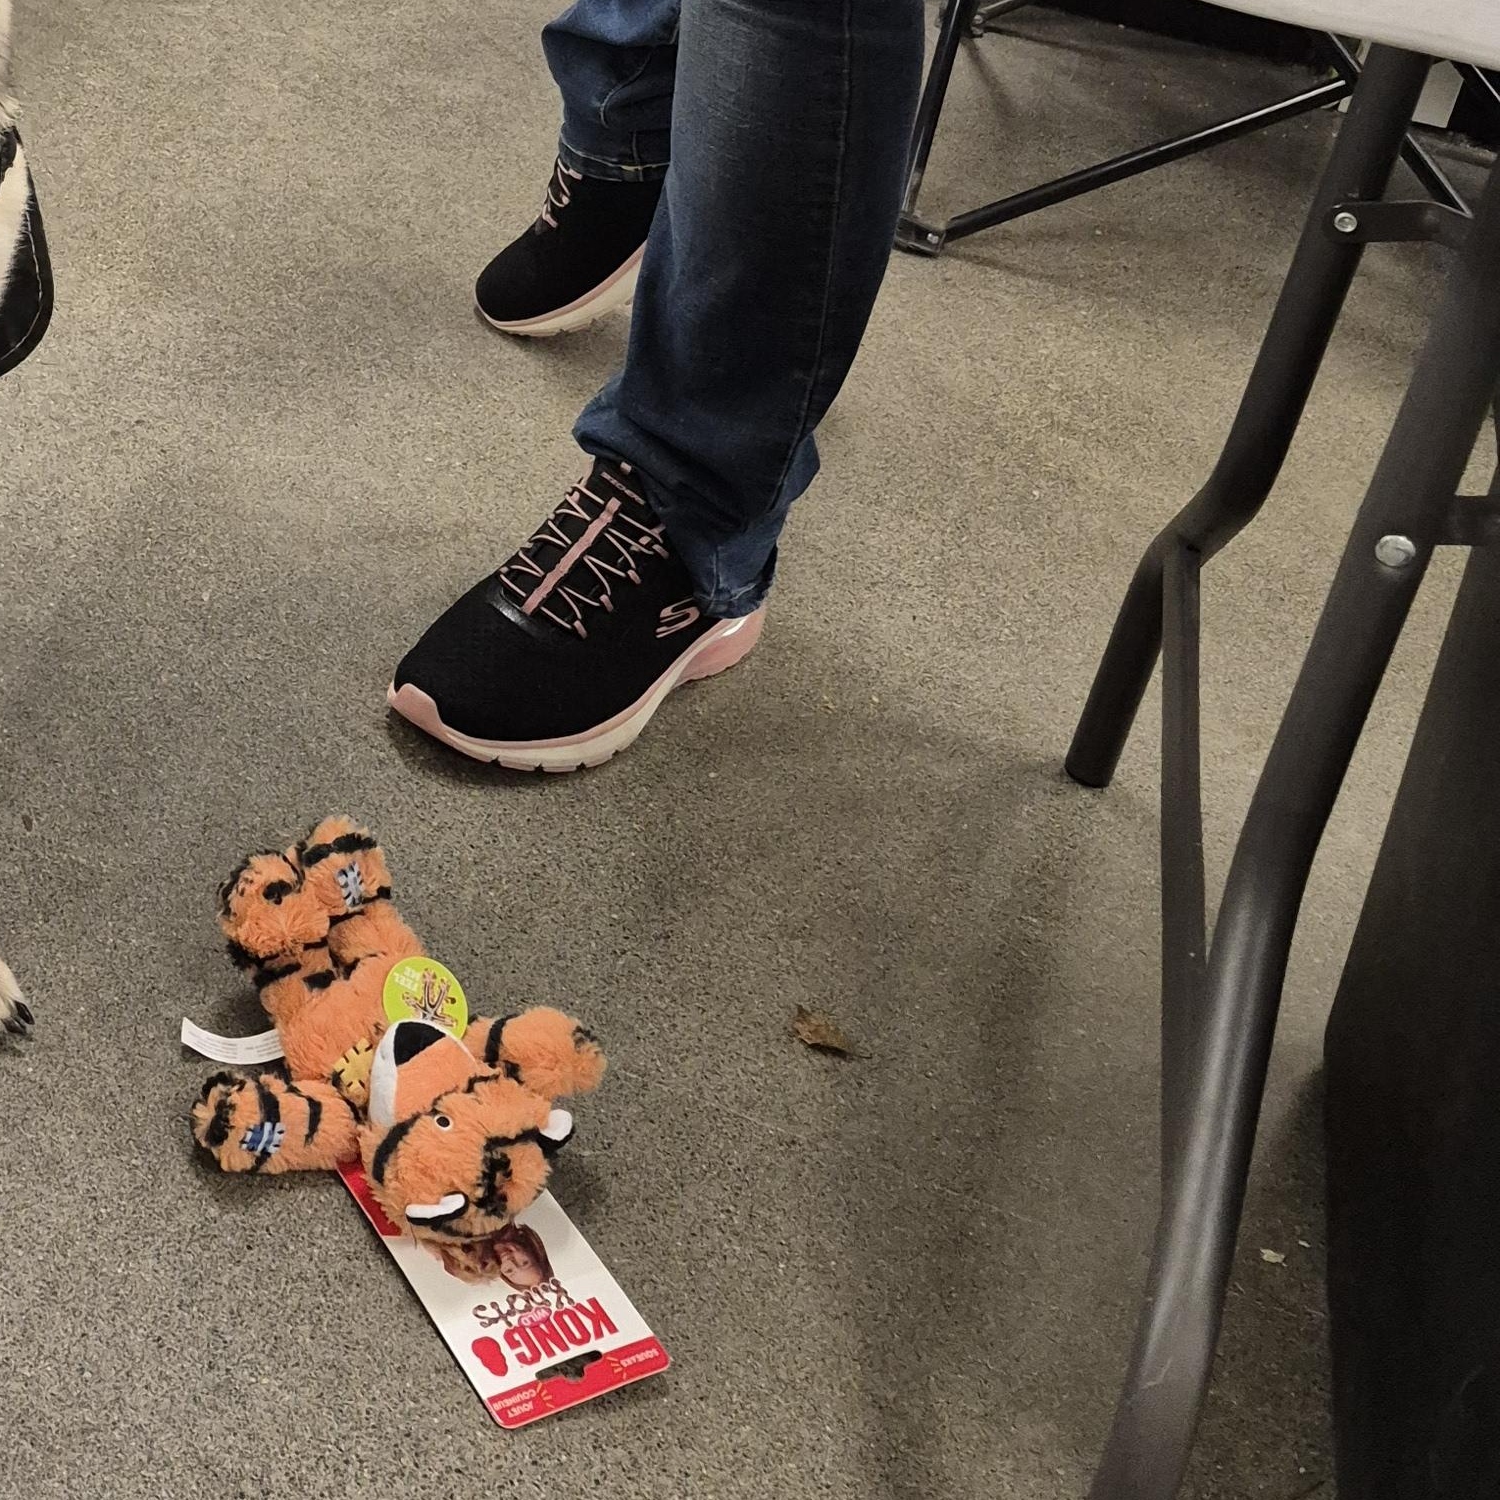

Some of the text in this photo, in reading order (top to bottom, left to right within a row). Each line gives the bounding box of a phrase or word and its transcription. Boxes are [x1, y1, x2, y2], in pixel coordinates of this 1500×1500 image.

[521, 1308, 550, 1327] WILD
[502, 1296, 619, 1366] KONG
[620, 1348, 661, 1368] SQUEAKS
[492, 1388, 537, 1412] COUINEUR
[506, 1400, 534, 1419] JOUET
